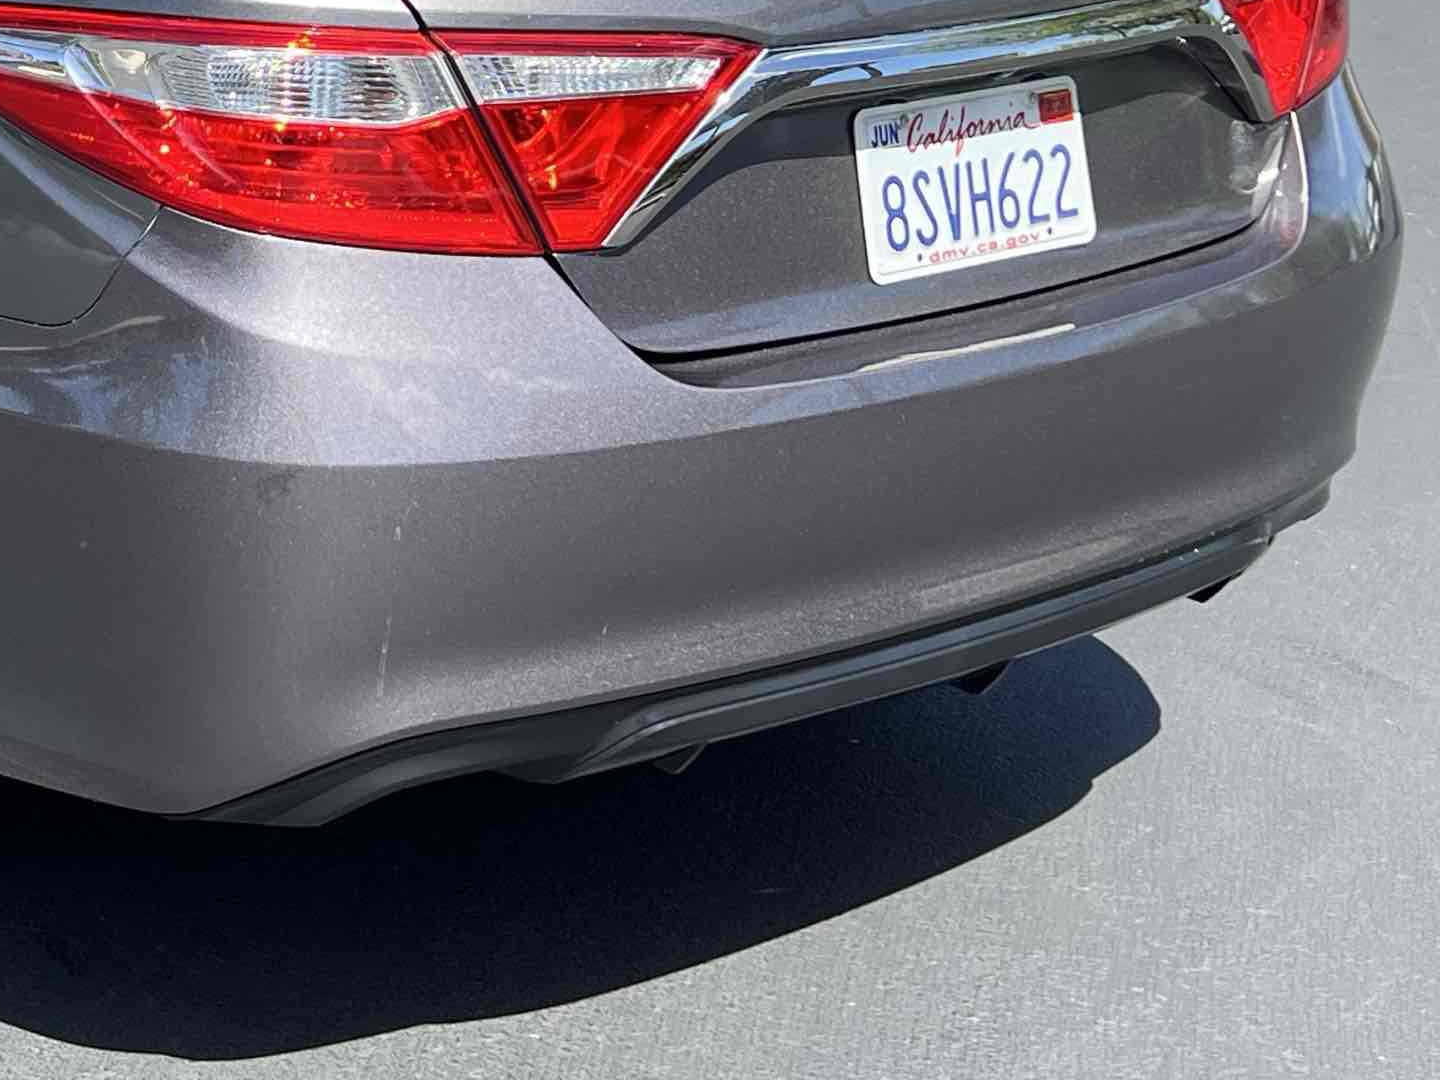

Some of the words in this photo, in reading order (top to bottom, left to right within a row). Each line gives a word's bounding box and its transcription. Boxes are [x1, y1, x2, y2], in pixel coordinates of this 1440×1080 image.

[871, 120, 900, 148] JUN
[907, 106, 1039, 155] California
[882, 144, 1078, 252] 8SVH622
[929, 231, 1041, 264] dmv.ca.gov
